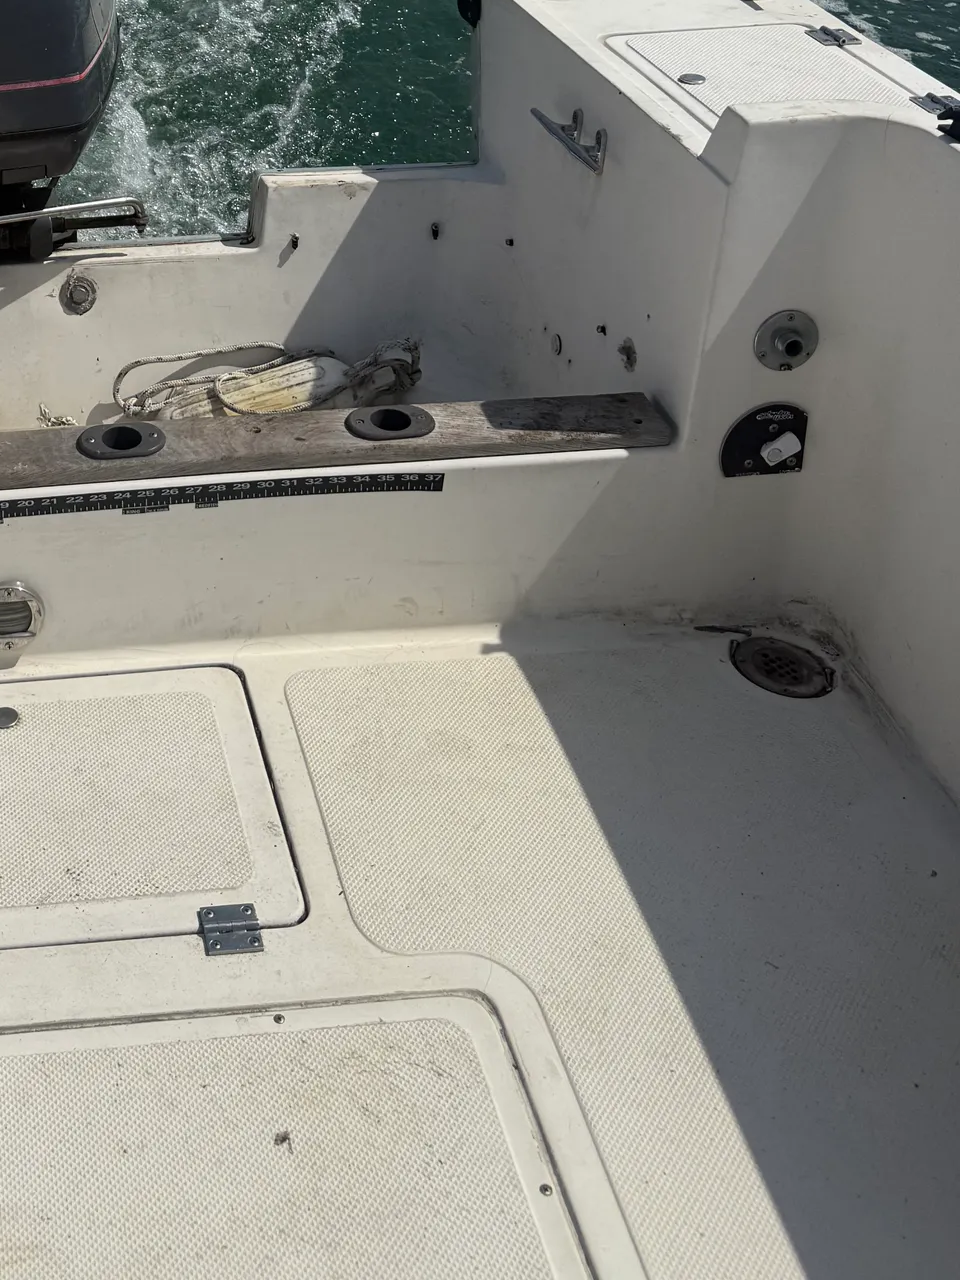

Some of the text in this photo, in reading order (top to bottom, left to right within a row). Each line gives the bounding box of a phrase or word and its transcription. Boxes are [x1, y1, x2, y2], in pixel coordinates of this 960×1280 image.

[208, 484, 227, 492] 28
[232, 482, 251, 490] 29
[256, 480, 275, 488] 30
[305, 477, 323, 485] 32
[328, 476, 347, 484] 33
[352, 475, 371, 483] 34
[377, 474, 395, 482] 35
